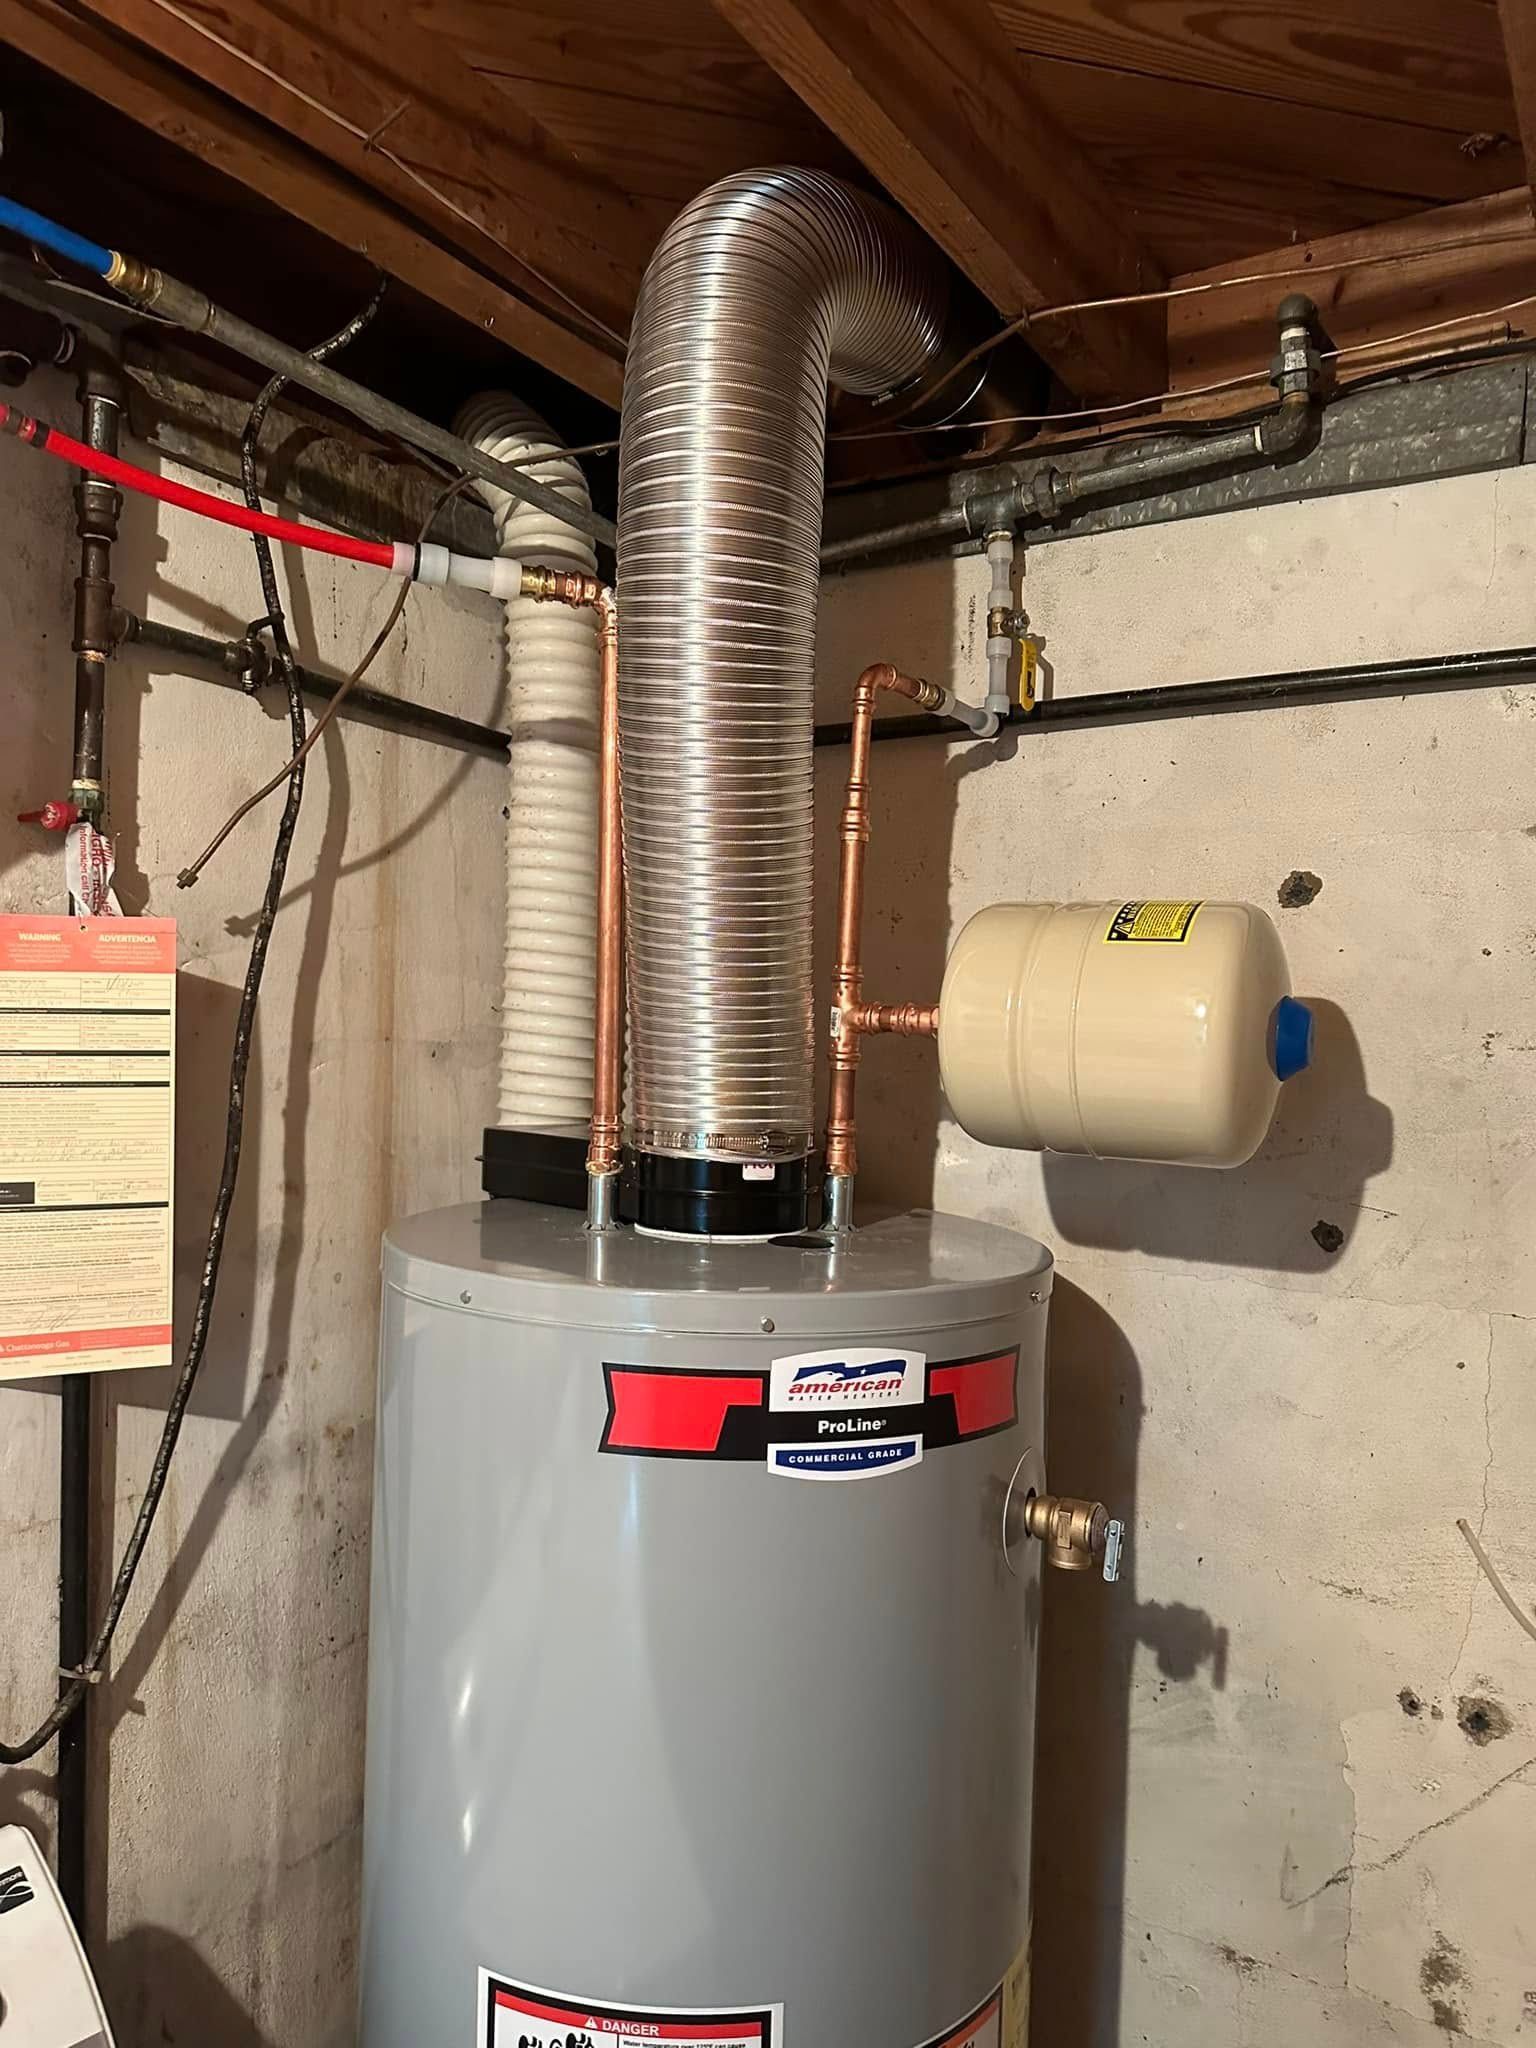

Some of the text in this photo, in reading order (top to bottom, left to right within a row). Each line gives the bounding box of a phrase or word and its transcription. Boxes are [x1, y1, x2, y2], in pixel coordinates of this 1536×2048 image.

[79, 825, 89, 873] Information
[18, 933, 61, 942] WARNING
[98, 934, 156, 943] ADVERTENCIA
[789, 1380, 902, 1394] american
[844, 1391, 900, 1400] HEATERS
[789, 1448, 902, 1464] COMMERCIAL GRADE
[603, 2021, 659, 2036] DANGER
